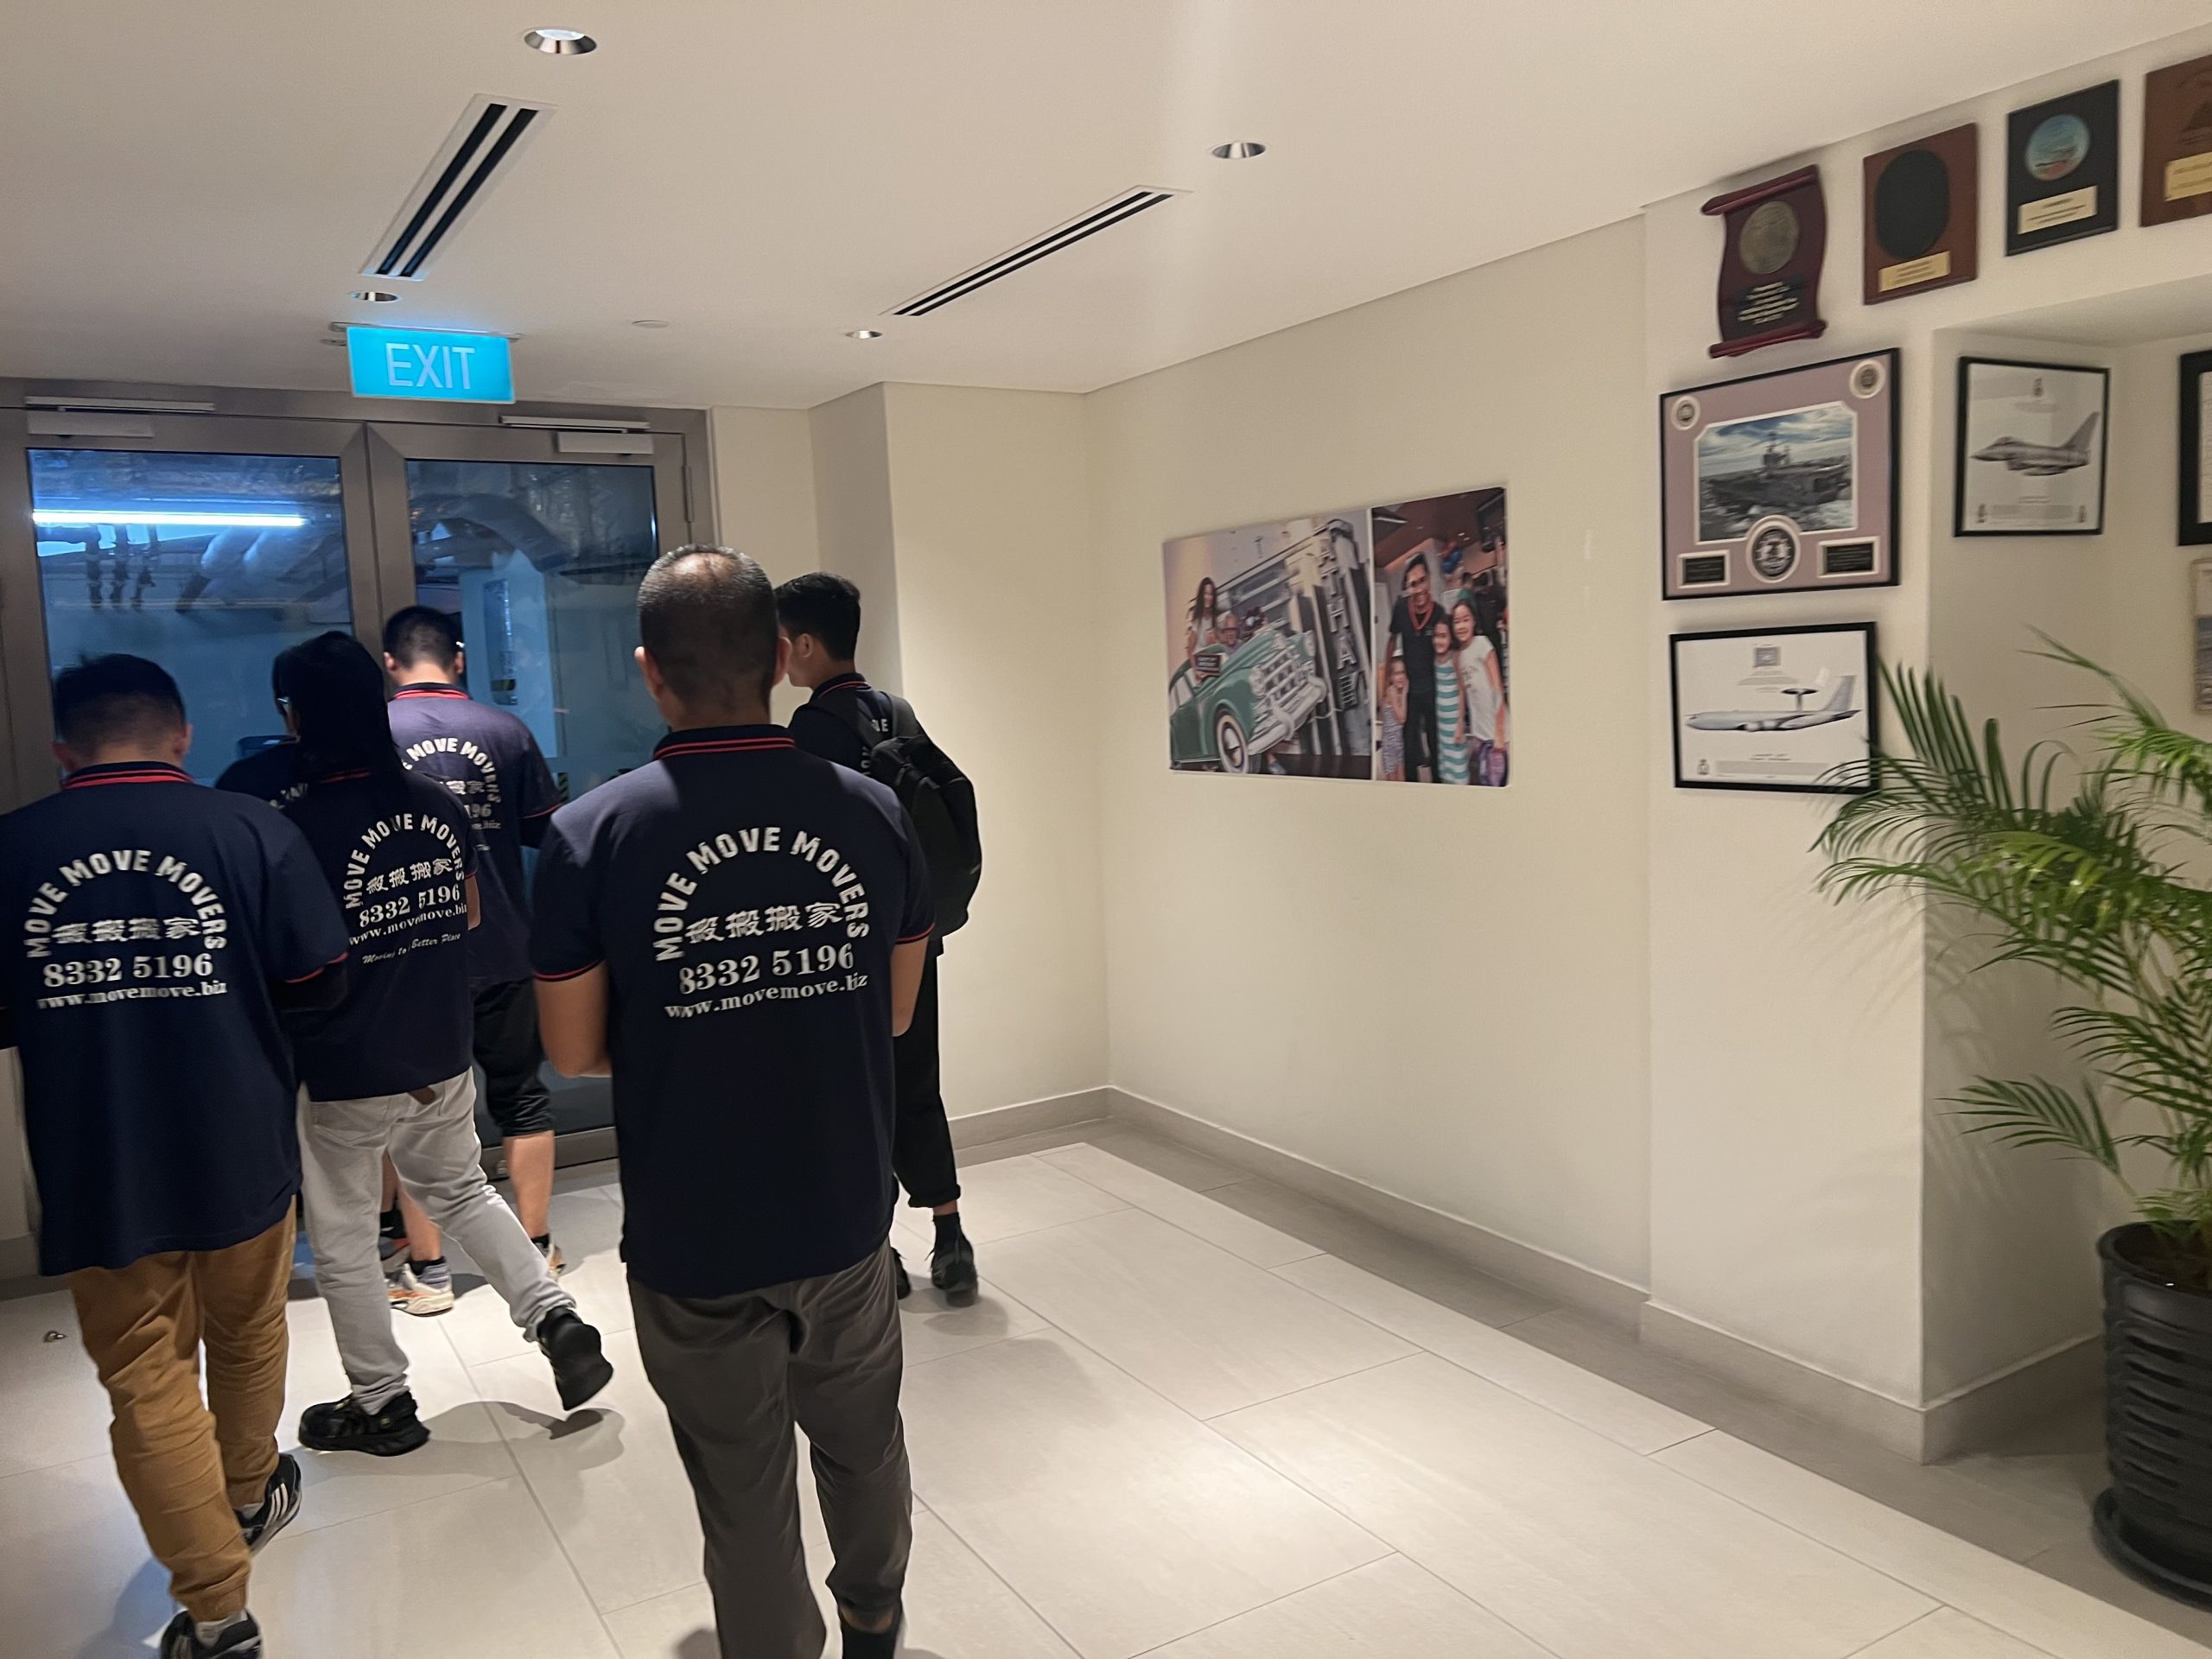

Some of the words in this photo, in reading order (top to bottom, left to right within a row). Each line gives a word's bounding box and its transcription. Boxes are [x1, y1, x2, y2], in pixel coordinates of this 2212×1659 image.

[385, 342, 476, 390] EXIT
[406, 738, 458, 761] MOVE
[464, 804, 492, 818] 196
[344, 849, 370, 909] MOVE
[361, 813, 413, 849] MOVE
[421, 814, 464, 880] MOVERS
[23, 882, 69, 957] MOVE
[59, 850, 151, 886] MOVE
[155, 856, 227, 949] MOVERS
[359, 897, 410, 927] 8332
[418, 884, 460, 908] 5196
[652, 872, 698, 961] MOVE
[685, 827, 781, 874] MOVE
[790, 830, 869, 938] MOVERS
[43, 958, 122, 987] 8332
[133, 953, 213, 978] 5196
[679, 955, 760, 994] 8332
[772, 943, 854, 976] 5196
[37, 980, 227, 1009] www.movemove.biz
[664, 972, 868, 1019] www.movemove.biz
